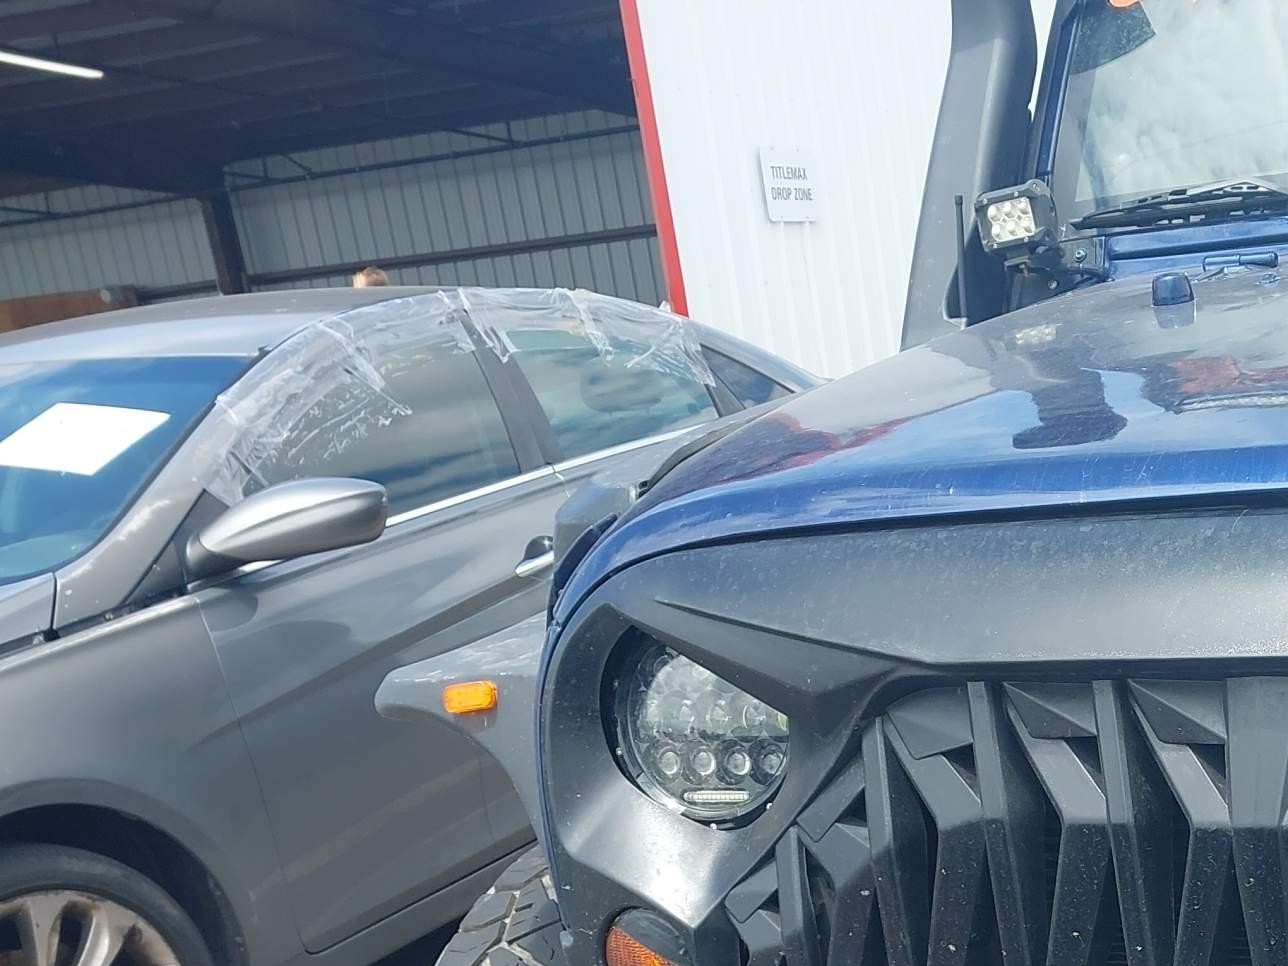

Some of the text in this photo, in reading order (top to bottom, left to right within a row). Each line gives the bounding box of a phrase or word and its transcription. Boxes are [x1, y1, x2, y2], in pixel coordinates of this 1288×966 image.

[770, 165, 808, 180] TITLEMAX
[771, 186, 814, 201] DROP ZONE
